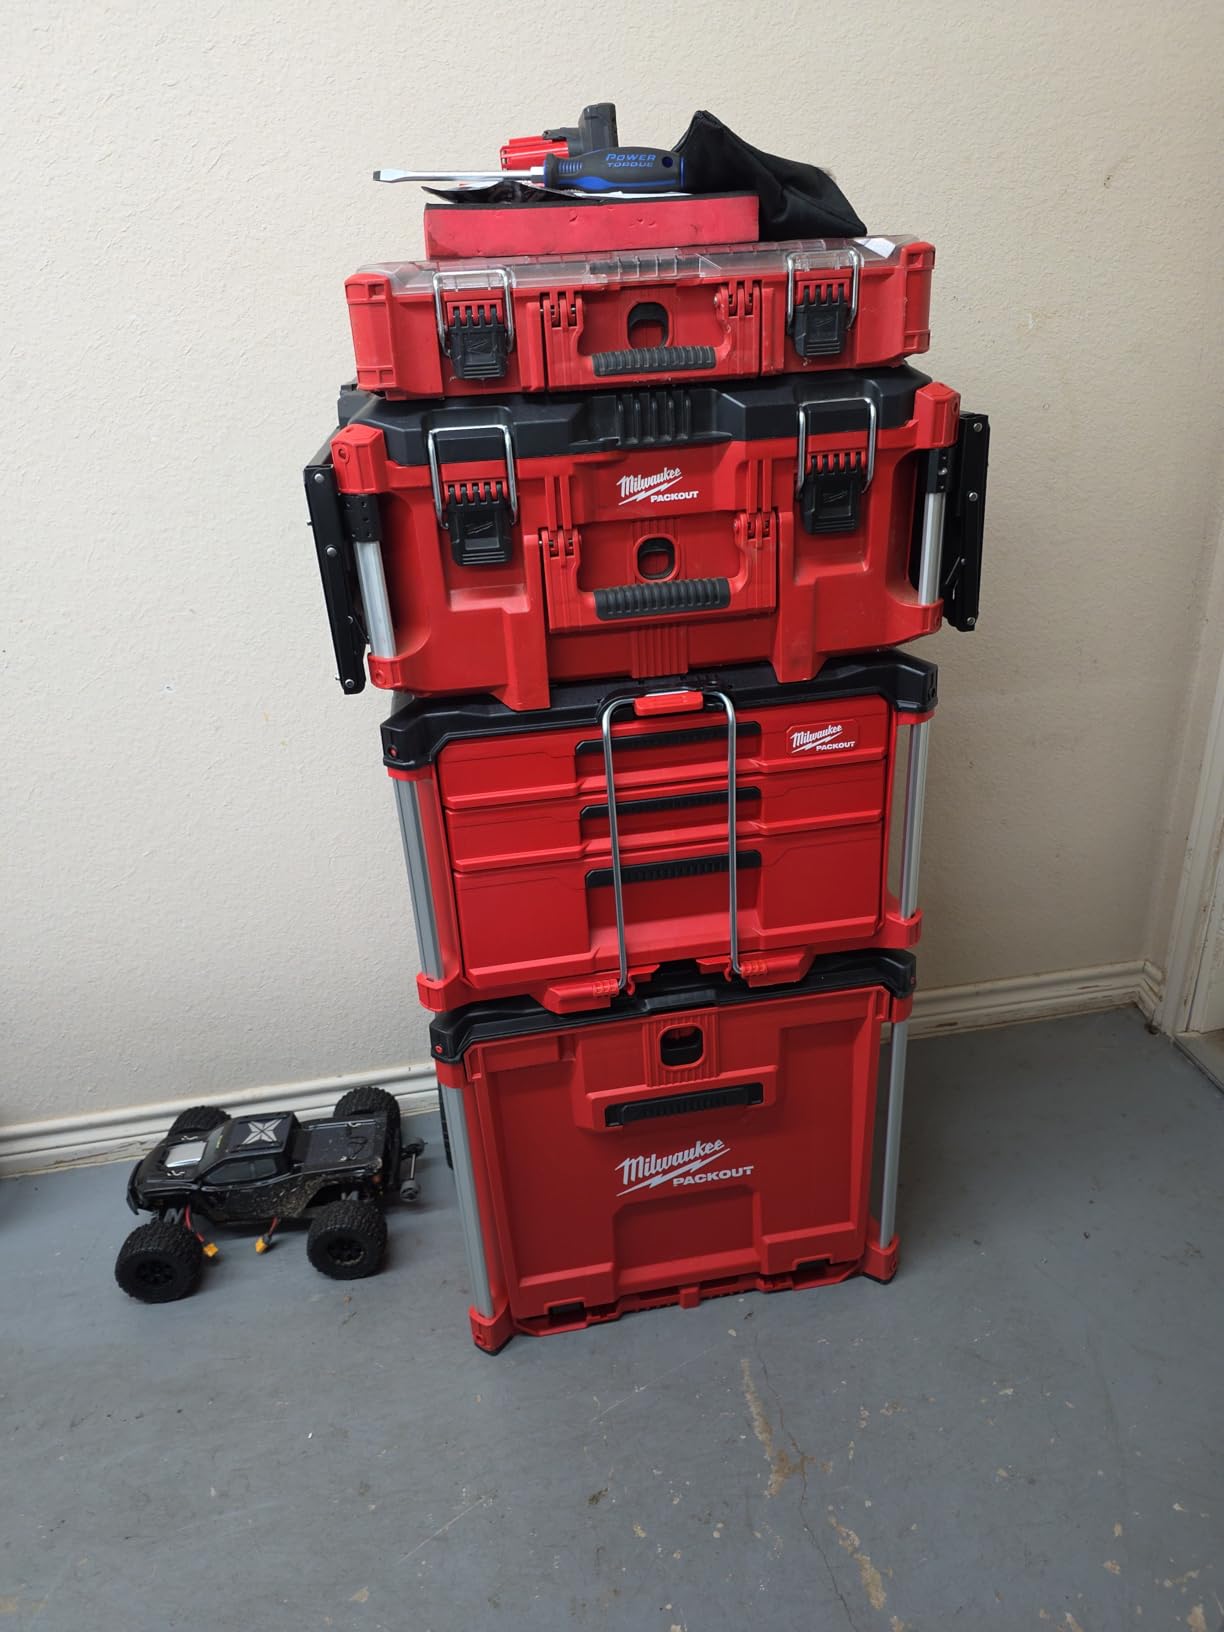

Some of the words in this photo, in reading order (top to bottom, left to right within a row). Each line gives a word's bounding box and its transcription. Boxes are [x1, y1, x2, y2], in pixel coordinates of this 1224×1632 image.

[605, 153, 657, 161] POWER
[616, 467, 682, 498] Milwaukee
[650, 490, 699, 503] PACKOUT
[789, 724, 843, 748] Milwaukee
[815, 741, 856, 752] PACKOUT
[614, 1139, 726, 1186] Milwaukee
[672, 1165, 755, 1187] PACKOUT
